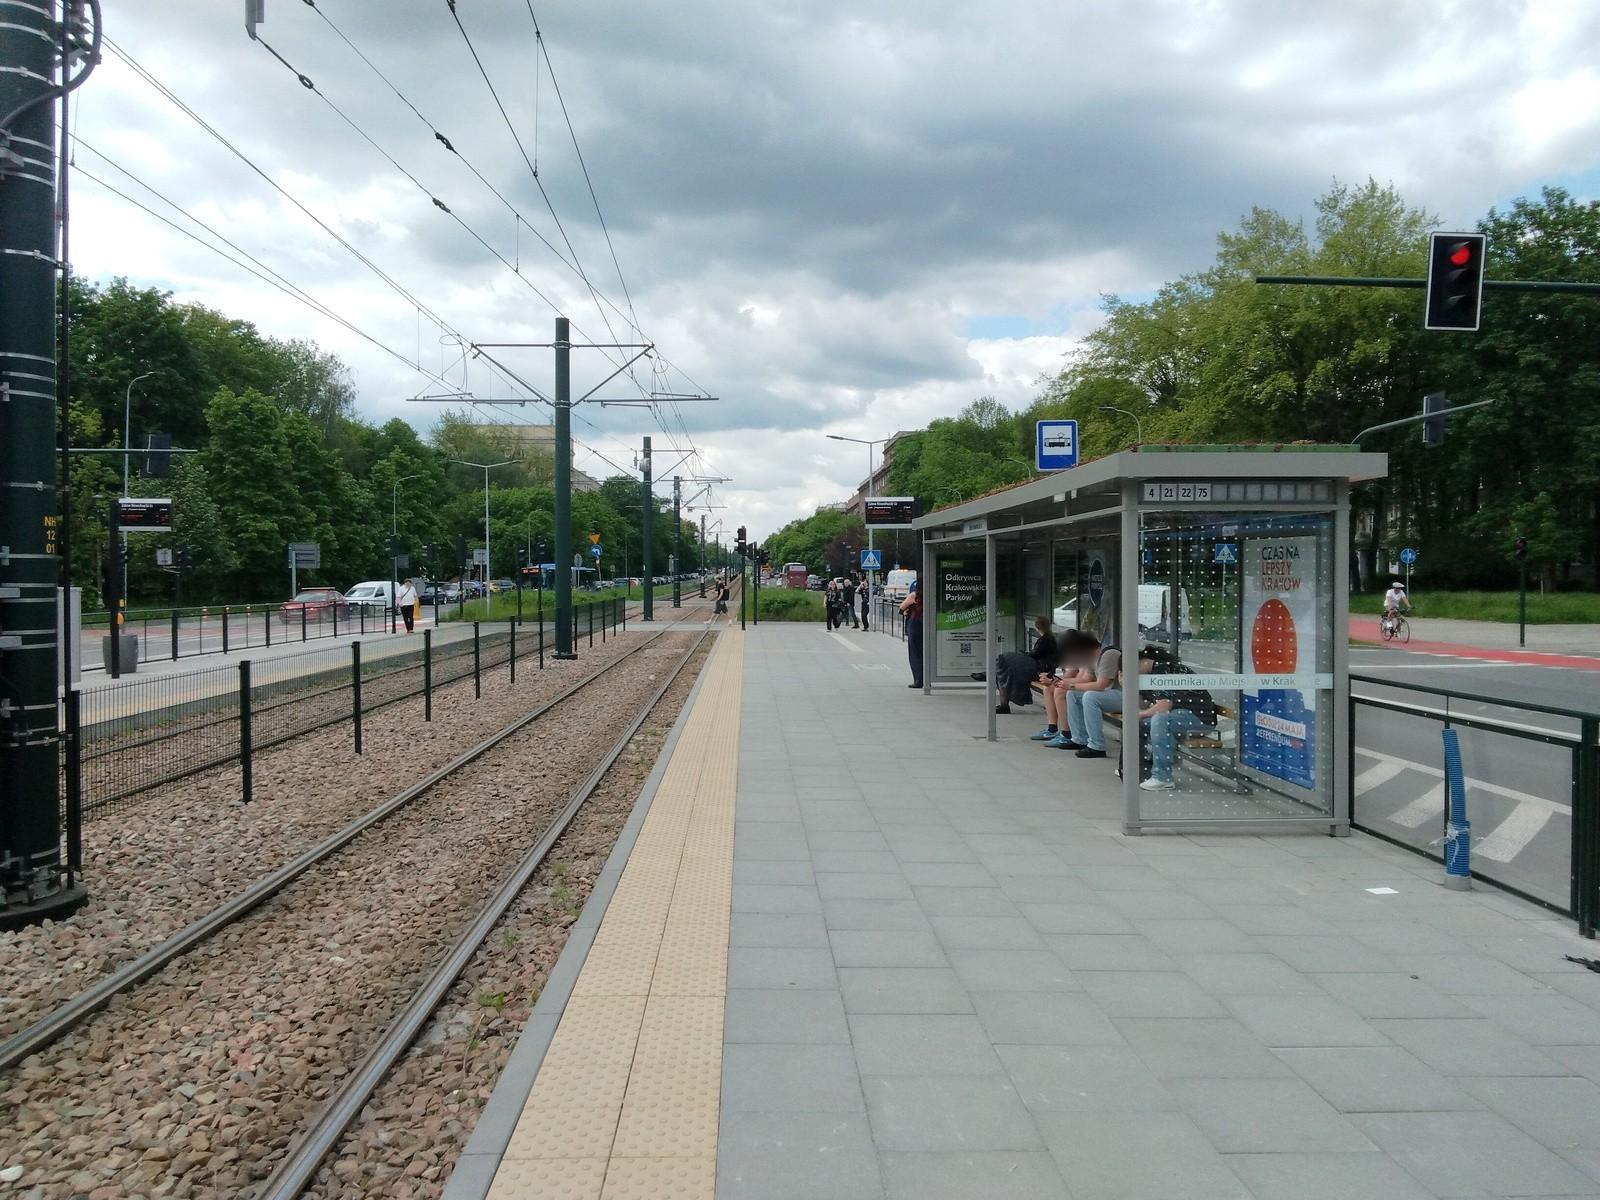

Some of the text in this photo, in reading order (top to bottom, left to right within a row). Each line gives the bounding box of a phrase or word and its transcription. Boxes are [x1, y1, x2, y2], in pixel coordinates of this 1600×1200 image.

[1148, 488, 1208, 498] 4 21 22 75
[46, 530, 56, 541] 12
[46, 543, 55, 554] 01
[1262, 546, 1300, 560] CZAS NA
[1262, 561, 1292, 576] LEPSZY
[945, 573, 982, 582] Odkrywca
[945, 583, 987, 591] Krakowskic
[945, 593, 973, 601] Parków
[1260, 678, 1271, 686] w
